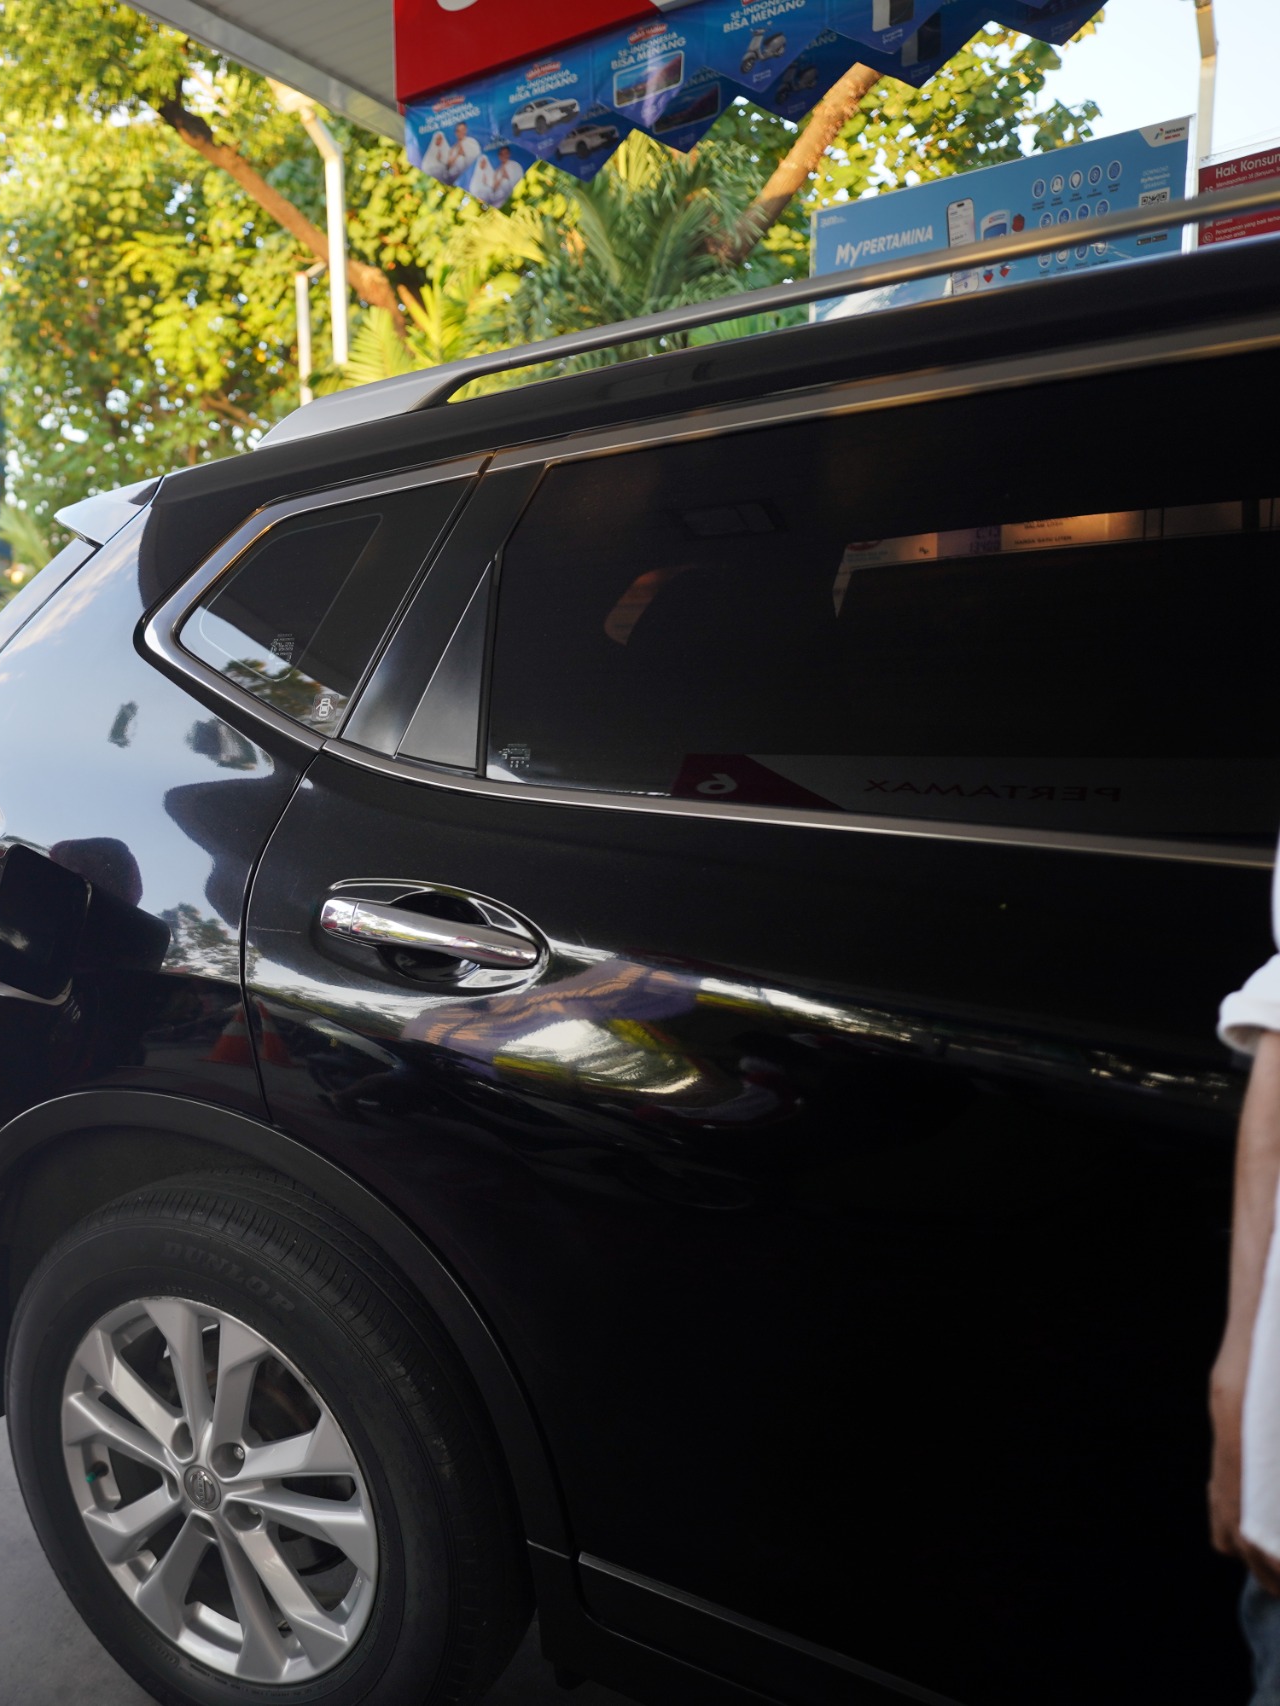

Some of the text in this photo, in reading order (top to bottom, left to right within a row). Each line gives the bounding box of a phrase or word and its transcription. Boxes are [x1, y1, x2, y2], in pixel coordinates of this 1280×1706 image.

[723, 0, 806, 33] BISA MENANG
[611, 37, 687, 70] BISA MENANG
[532, 73, 578, 97] MENANG
[440, 106, 481, 130] MENANG
[1215, 164, 1237, 179] Hak
[835, 225, 933, 267] MyPERTAMINA
